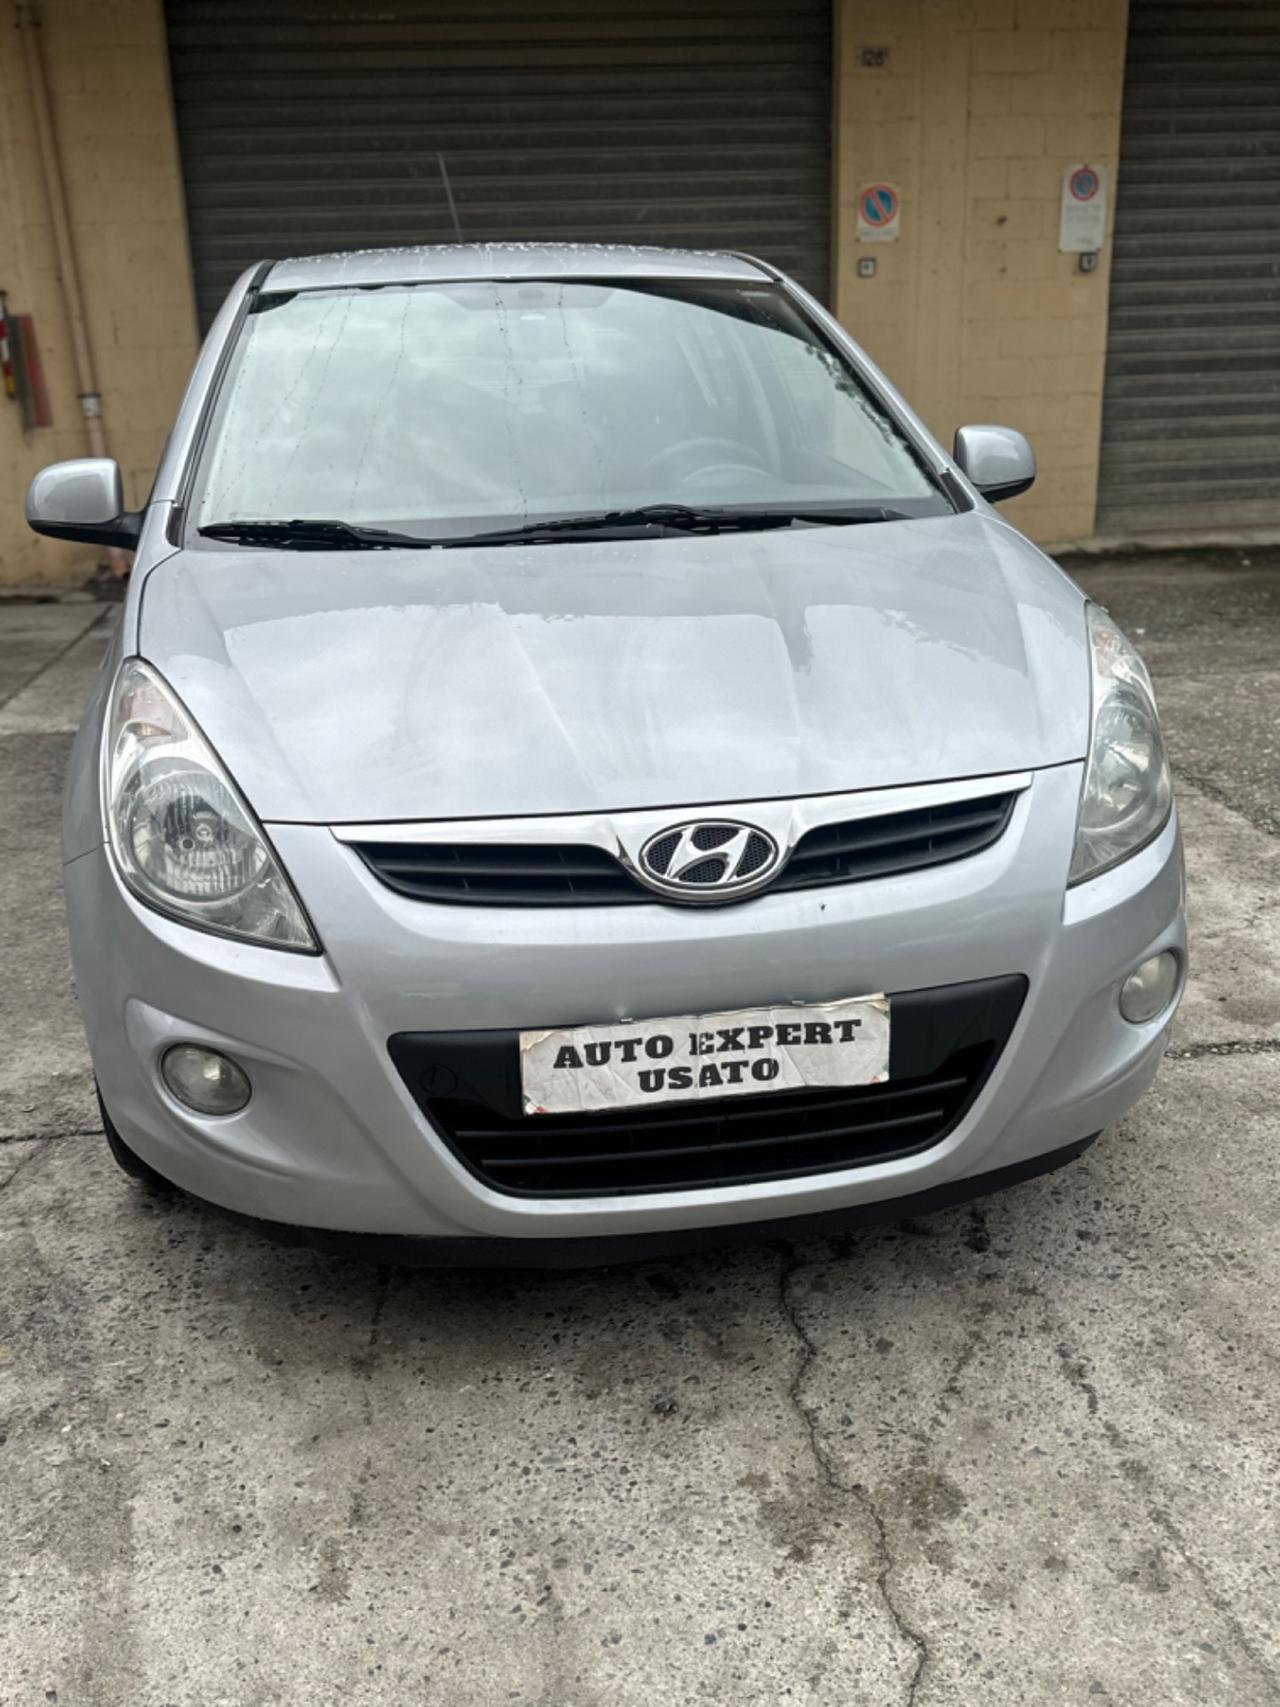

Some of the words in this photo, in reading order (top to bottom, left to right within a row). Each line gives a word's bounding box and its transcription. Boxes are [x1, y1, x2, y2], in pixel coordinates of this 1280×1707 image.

[553, 1033, 674, 1069] AUTO
[688, 1018, 863, 1056] EXPERT
[637, 1057, 780, 1093] USATO
